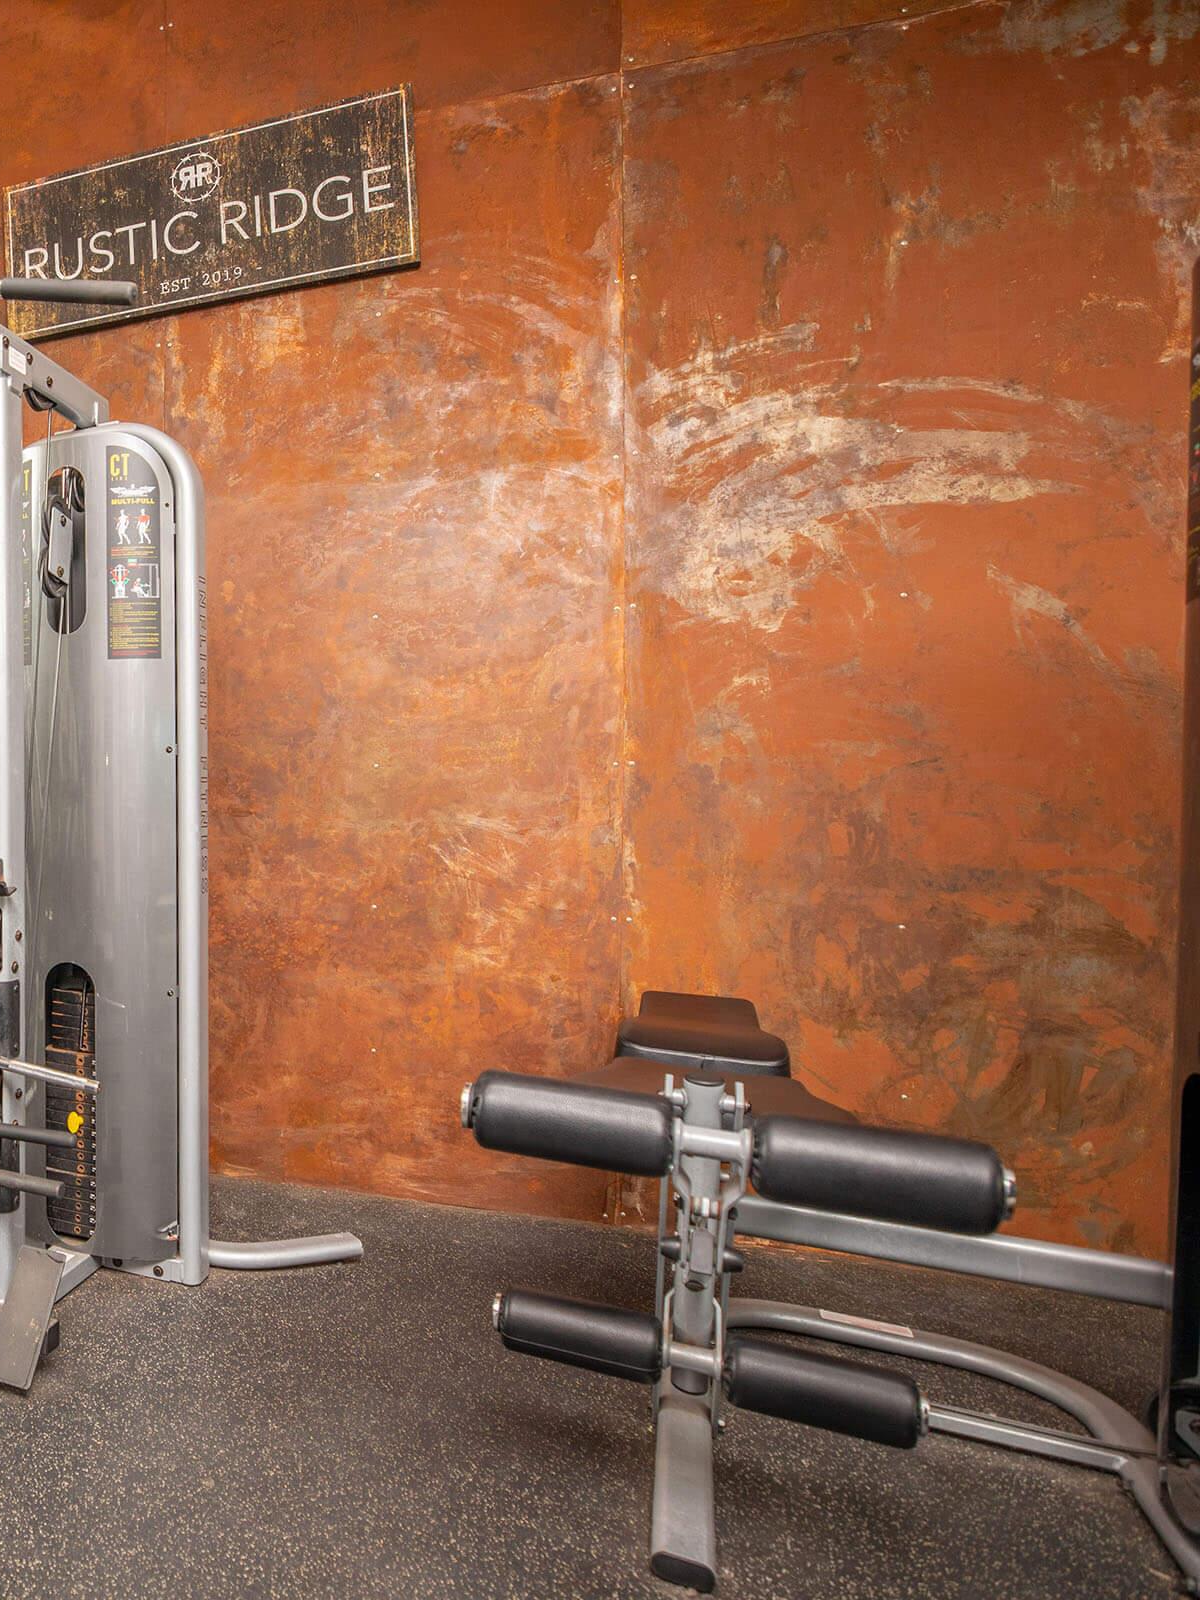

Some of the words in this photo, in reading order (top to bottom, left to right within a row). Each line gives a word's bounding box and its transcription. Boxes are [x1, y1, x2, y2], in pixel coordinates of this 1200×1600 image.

[24, 210, 200, 280] RUSTIC
[220, 165, 395, 244] RIDGE
[160, 278, 191, 294] EST
[202, 266, 242, 286] 2019
[110, 453, 129, 476] CT
